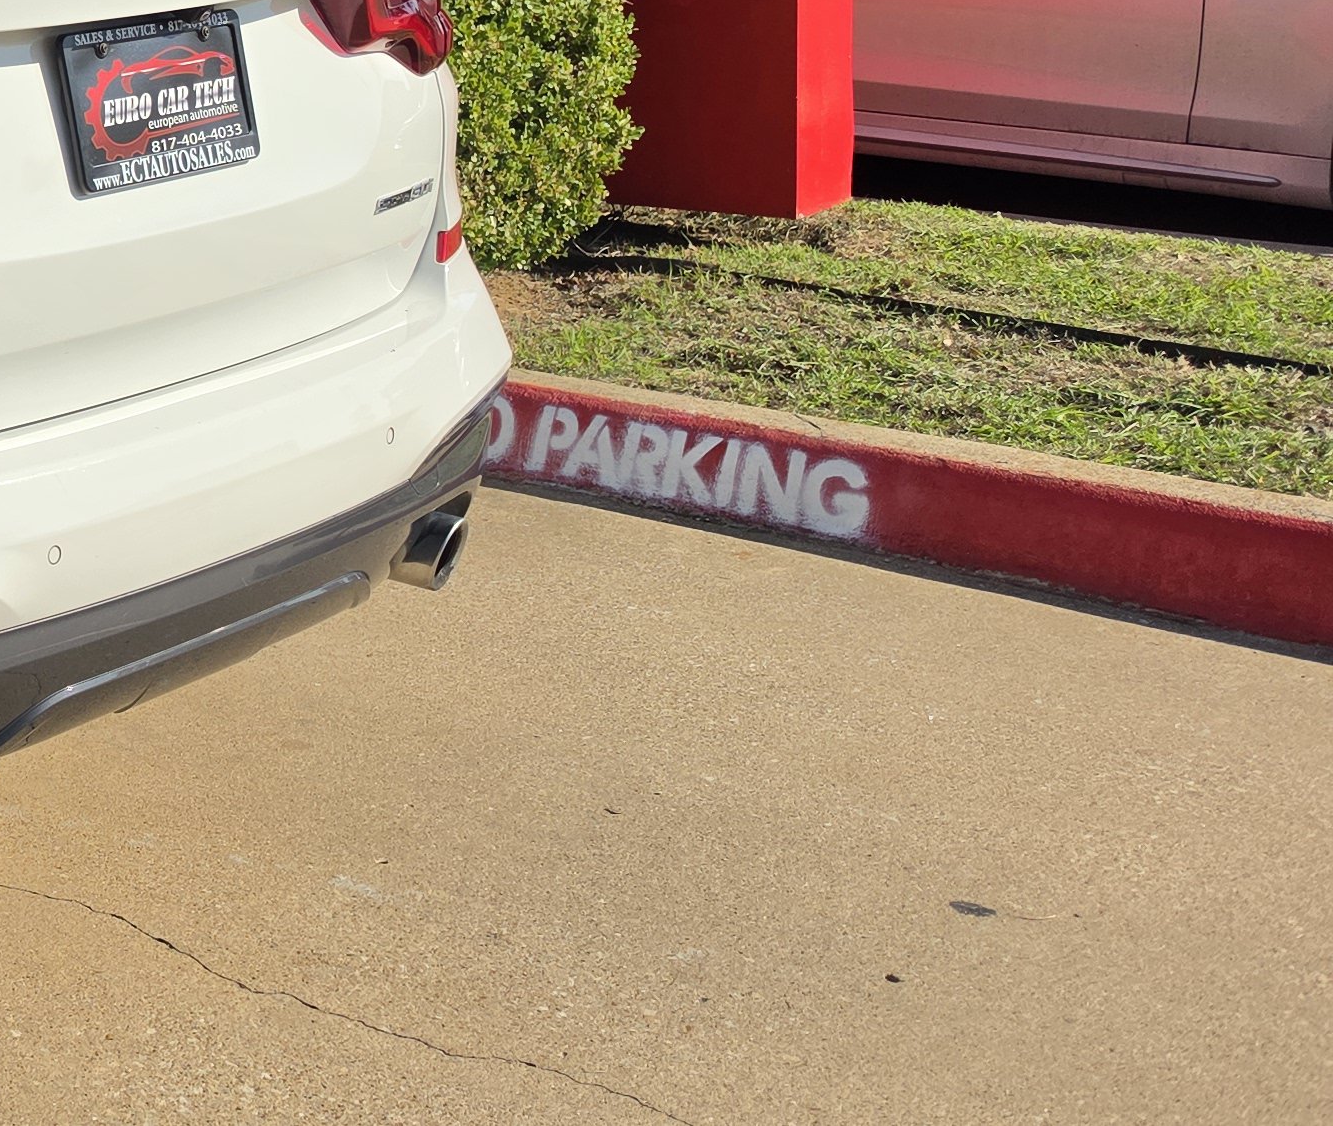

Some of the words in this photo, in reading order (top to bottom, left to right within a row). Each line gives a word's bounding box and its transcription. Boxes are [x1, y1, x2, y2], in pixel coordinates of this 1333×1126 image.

[74, 32, 104, 46] SALES
[105, 30, 116, 42] &
[116, 23, 156, 39] SERVICE
[103, 92, 153, 127] EURO
[157, 85, 190, 116] CAR
[192, 75, 236, 109] TECH
[148, 113, 189, 130] european
[189, 102, 239, 121] automotive
[151, 123, 244, 153] 817-404-4033
[92, 140, 256, 191] www.ECTAUTOSALES.com
[525, 405, 872, 541] PARKING
